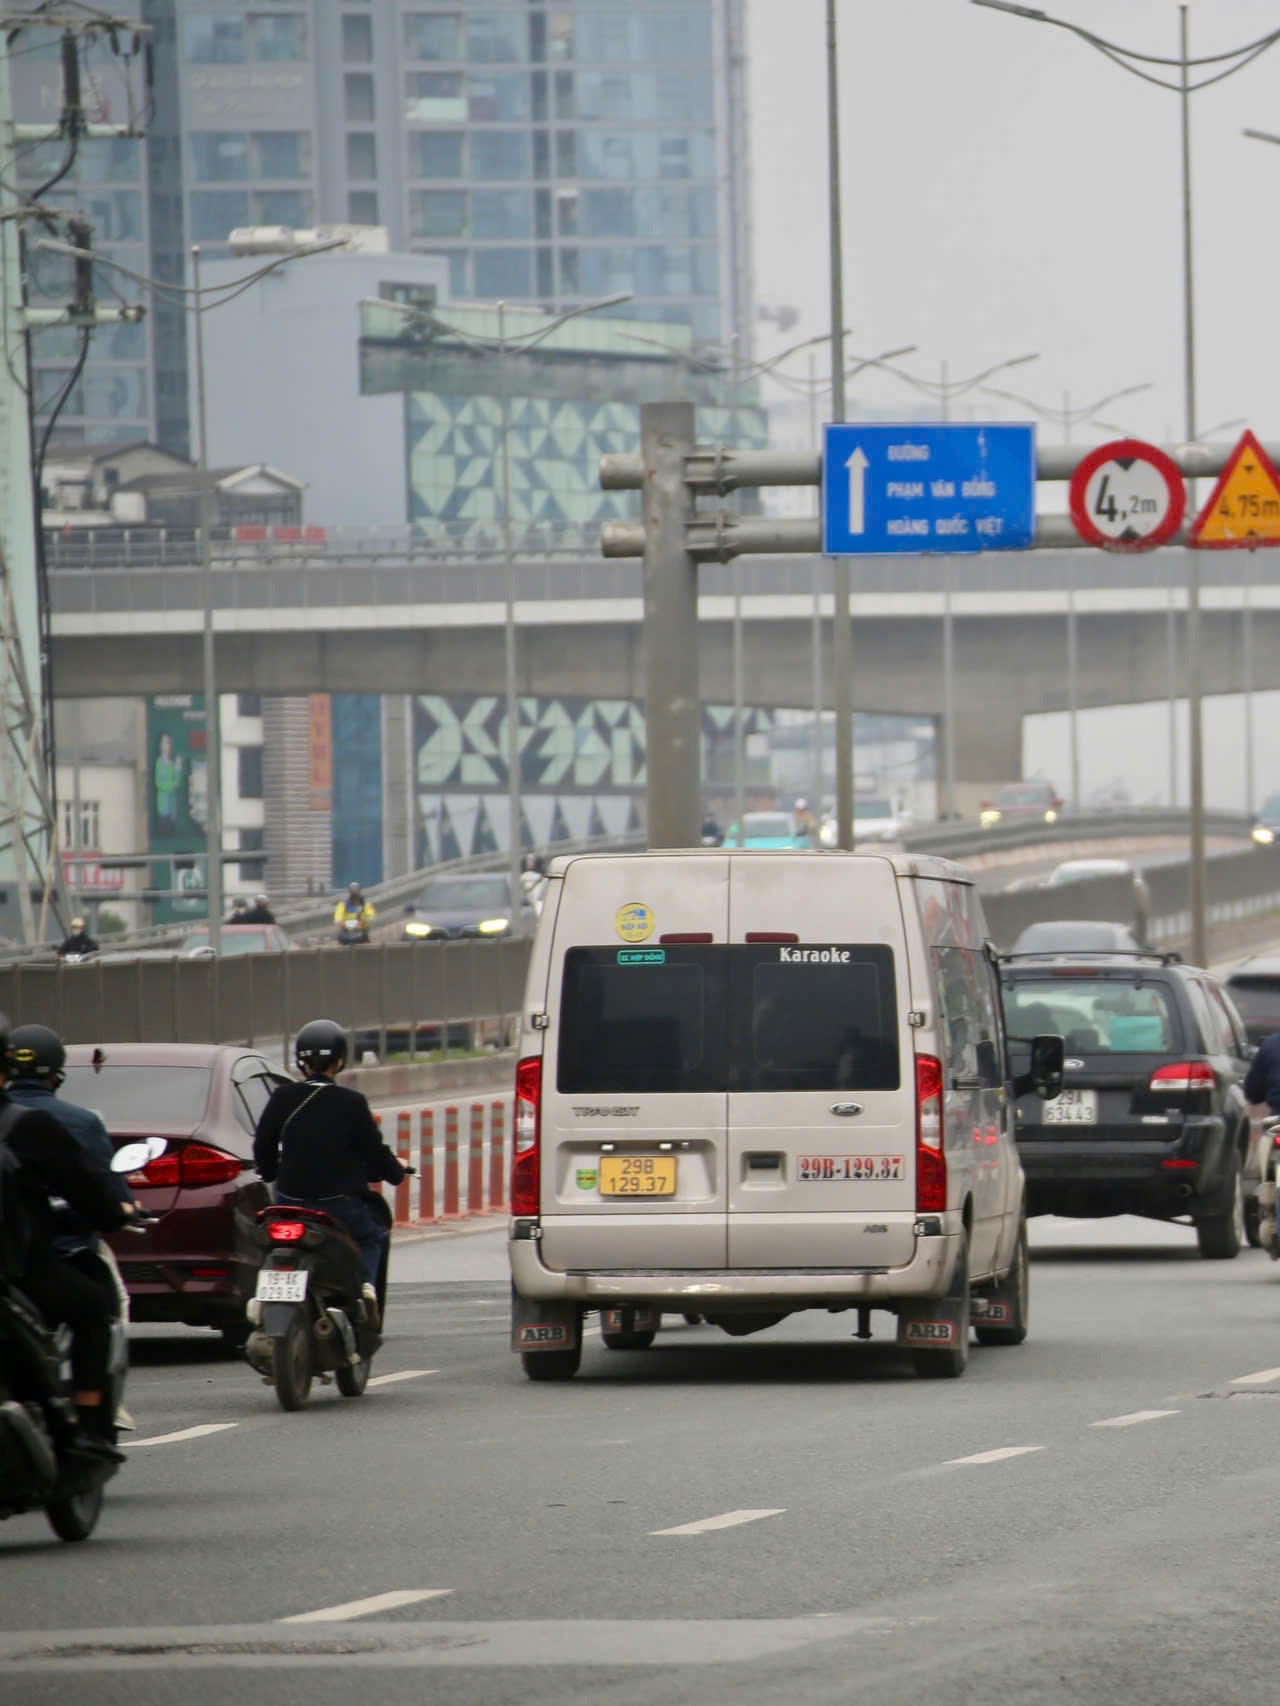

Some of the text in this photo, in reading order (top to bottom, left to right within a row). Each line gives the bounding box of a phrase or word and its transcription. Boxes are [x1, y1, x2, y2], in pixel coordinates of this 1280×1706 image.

[886, 481, 924, 500] PHẠM
[887, 512, 1004, 536] HOÀNG QUỐC VIỆT
[779, 947, 851, 963] Karaoke
[572, 1105, 641, 1117] TRANSIT
[1046, 1106, 1095, 1122] 63443
[621, 1158, 655, 1175] 29B
[800, 1156, 901, 1179] 29B-129.37
[609, 1176, 668, 1193] 129.37
[522, 1327, 565, 1343] ARB
[909, 1323, 951, 1340] ARB
